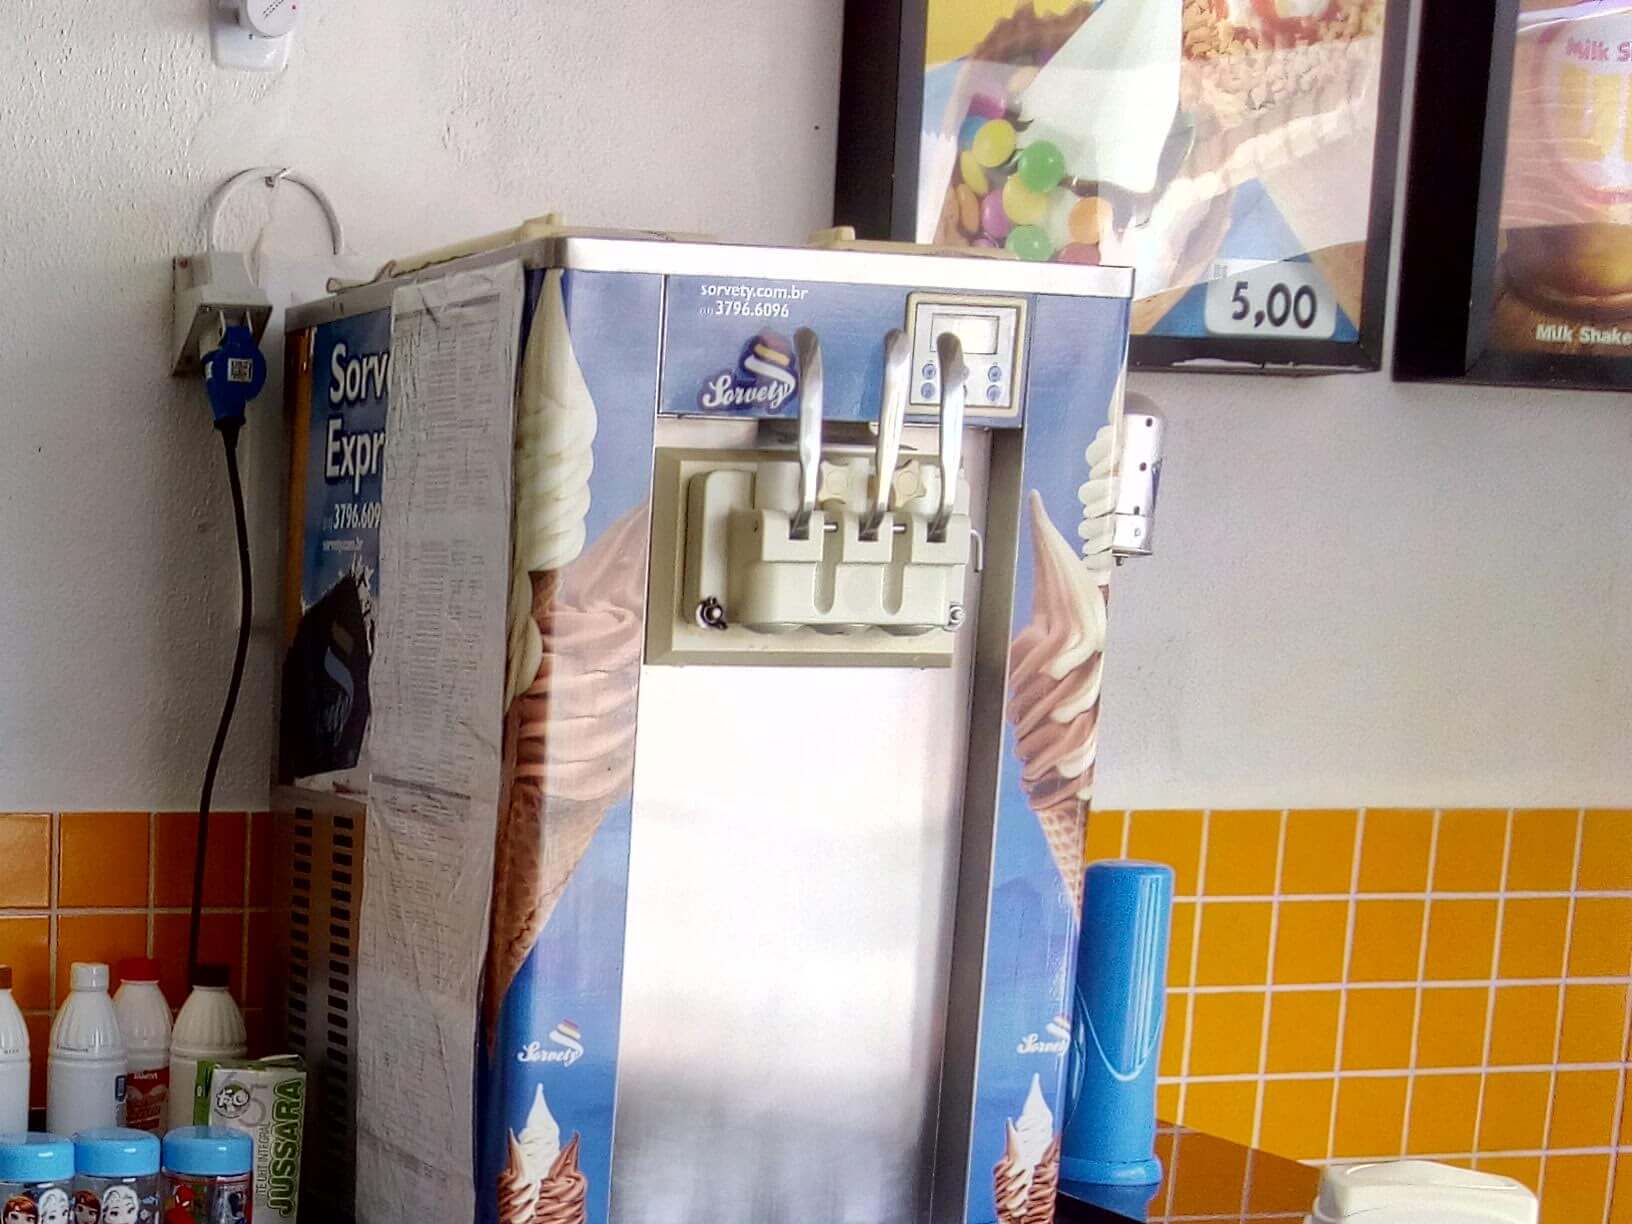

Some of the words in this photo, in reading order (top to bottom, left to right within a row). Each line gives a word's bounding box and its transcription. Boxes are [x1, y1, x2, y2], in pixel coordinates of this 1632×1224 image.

[1567, 37, 1608, 61] Milk
[1616, 41, 1632, 62] S
[701, 285, 808, 300] sorvety.com.br
[1231, 281, 1317, 329] 5,00
[715, 300, 789, 317] 3796.6096
[1535, 324, 1573, 342] Milk
[1578, 325, 1632, 346] Shake
[702, 374, 795, 409] Sorvety
[325, 419, 385, 494] Expr
[268, 1078, 304, 1217] JUSSARA
